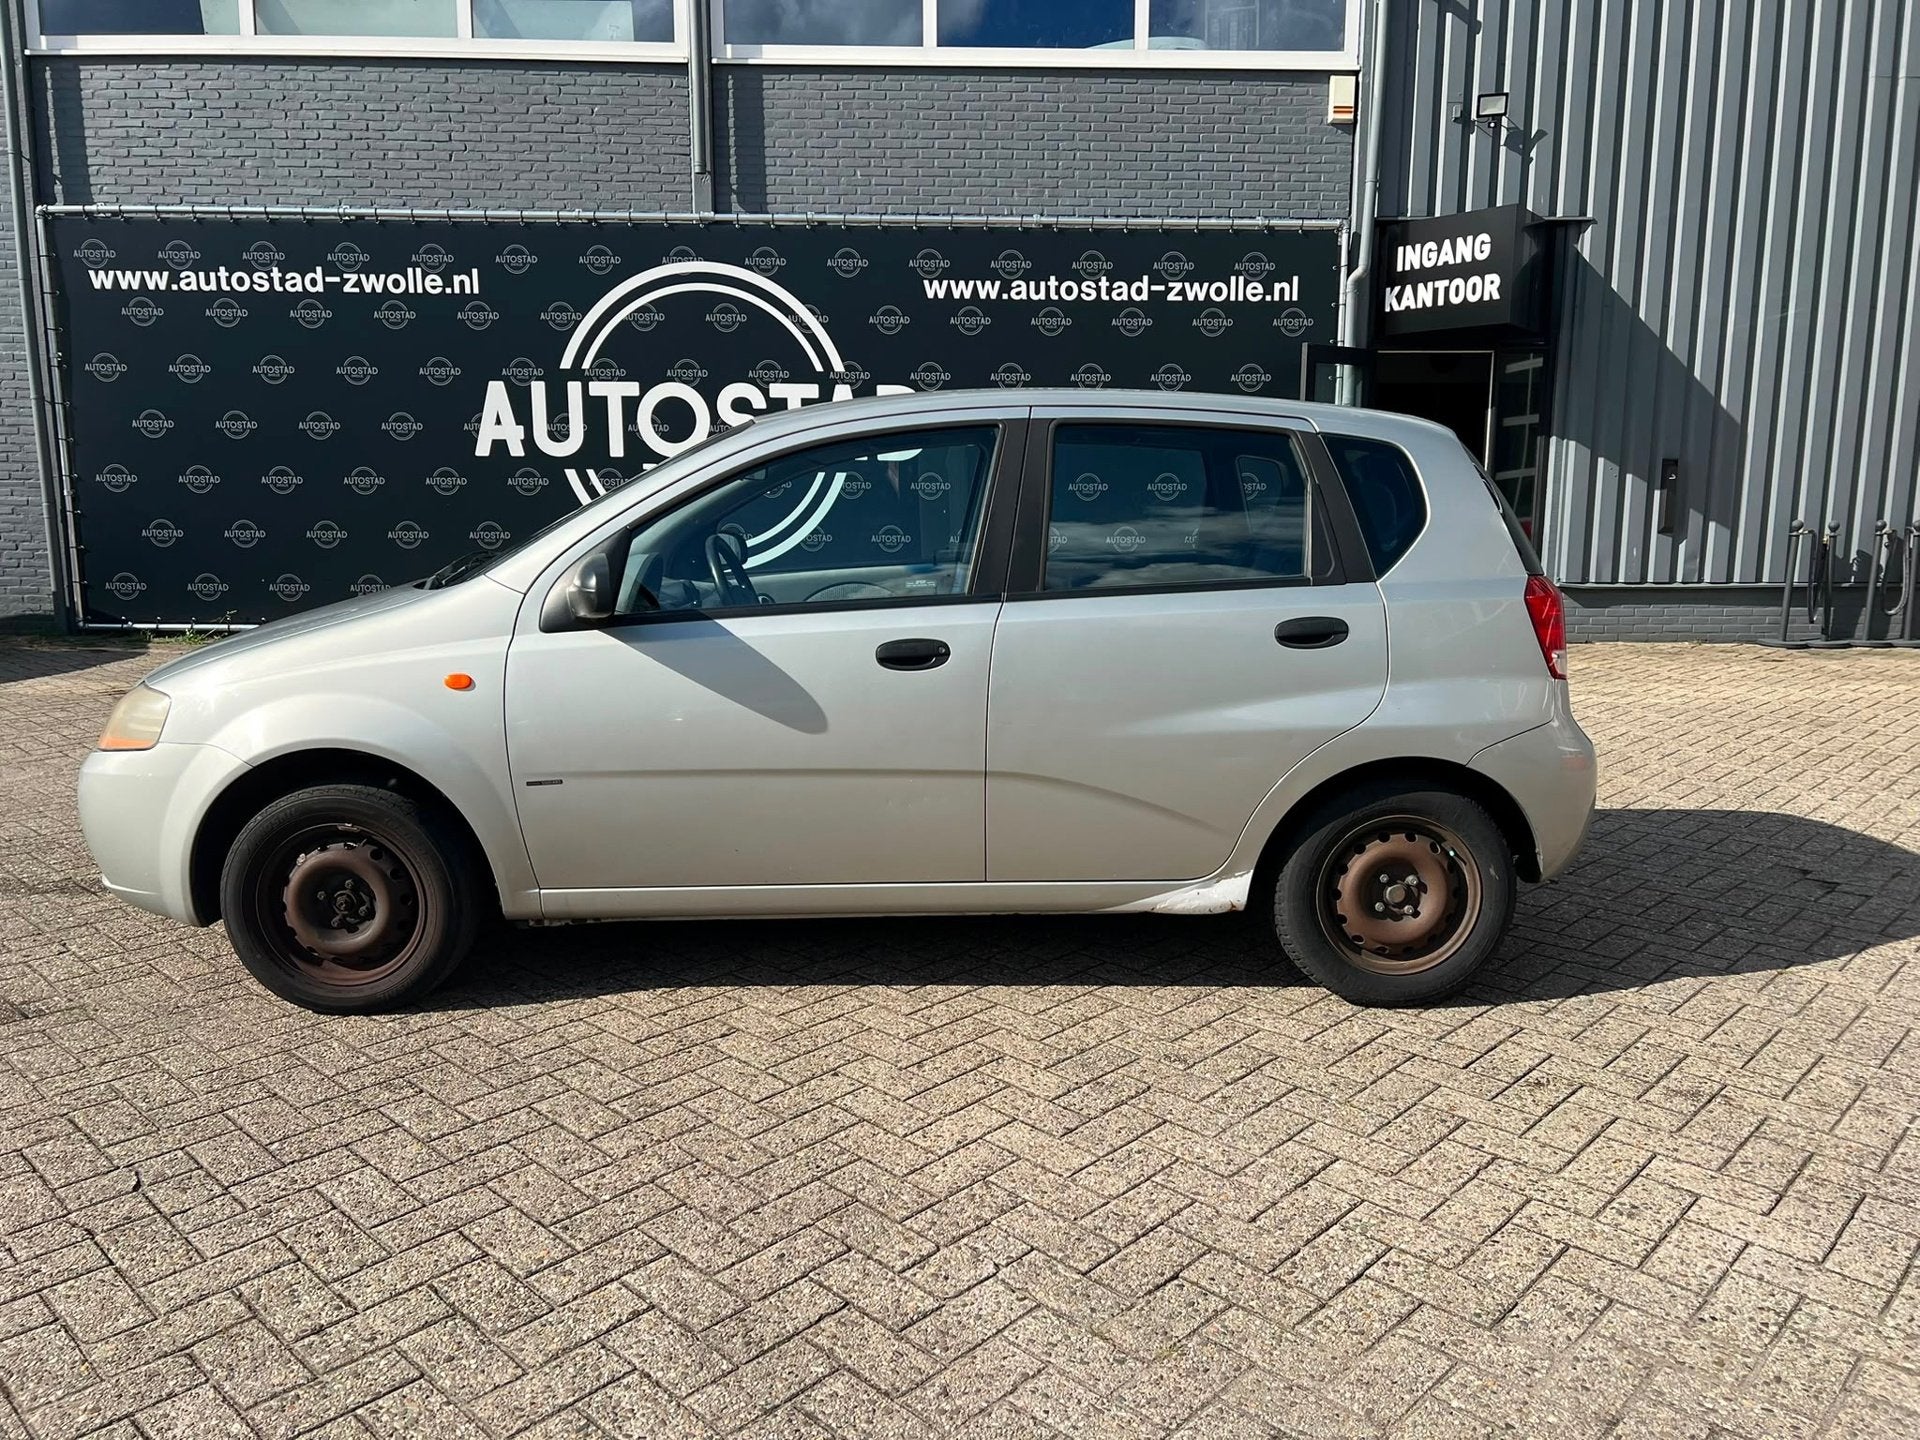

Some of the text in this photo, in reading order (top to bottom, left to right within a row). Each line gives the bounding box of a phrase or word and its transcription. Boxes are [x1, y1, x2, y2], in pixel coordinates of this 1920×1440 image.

[73, 249, 116, 258] AUTOSTAD
[158, 250, 200, 259] AUTOSTAD
[242, 251, 285, 260] AUTOSTAD
[327, 252, 370, 262] AUTOSTAD
[1396, 233, 1492, 272] INGANG
[411, 254, 454, 263] AUTOSTAD
[496, 254, 538, 263] AUTOSTAD
[579, 255, 621, 264] AUTOSTAD
[744, 257, 786, 266] AUTOSTAD
[827, 258, 868, 267] AUTOSTAD
[909, 259, 950, 268] AUTOSTAD
[991, 260, 1031, 269] AUTOSTAD
[1072, 261, 1113, 270] AUTOSTAD
[1153, 261, 1194, 270] AUTOSTAD
[1234, 262, 1275, 271] AUTOSTAD
[88, 266, 479, 294] www.autostad-zwolle.nl
[923, 275, 1299, 302] www.autostad-zwolle.nl
[1384, 273, 1501, 312] KANTOOR
[121, 307, 164, 316] AUTOSTAD
[205, 308, 248, 317] AUTOSTAD
[290, 309, 332, 318] AUTOSTAD
[373, 310, 416, 319] AUTOSTAD
[457, 311, 500, 320] AUTOSTAD
[540, 311, 582, 320] AUTOSTAD
[706, 313, 747, 322] AUTOSTAD
[869, 315, 910, 324] AUTOSTAD
[950, 316, 991, 325] AUTOSTAD
[1031, 317, 1072, 326] AUTOSTAD
[1112, 318, 1152, 327] AUTOSTAD
[1192, 318, 1233, 327] AUTOSTAD
[1273, 318, 1313, 327] AUTOSTAD
[85, 363, 127, 372] AUTOSTAD
[168, 364, 211, 373] AUTOSTAD
[252, 365, 295, 374] AUTOSTAD
[336, 366, 378, 375] AUTOSTAD
[419, 366, 461, 375] AUTOSTAD
[502, 367, 544, 376] AUTOSTAD
[584, 368, 626, 377] AUTOSTAD
[666, 368, 708, 377] AUTOSTAD
[748, 369, 789, 378] AUTOSTAD
[829, 371, 870, 380] AUTOSTAD
[910, 372, 950, 381] AUTOSTAD
[990, 373, 1031, 382] AUTOSTAD
[1070, 373, 1111, 382] AUTOSTAD
[1151, 373, 1191, 382] AUTOSTAD
[1231, 373, 1271, 382] AUTOSTAD
[132, 420, 174, 429] AUTOSTAD
[215, 421, 257, 430] AUTOSTAD
[299, 421, 341, 430] AUTOSTAD
[381, 422, 423, 431] AUTOSTAD
[96, 474, 138, 483] AUTOSTAD
[178, 475, 220, 484] AUTOSTAD
[261, 476, 303, 485] AUTOSTAD
[344, 476, 385, 485] AUTOSTAD
[425, 477, 467, 486] AUTOSTAD
[507, 477, 549, 486] AUTOSTAD
[911, 481, 951, 490] AUTOSTAD
[1068, 483, 1108, 491] AUTOSTAD
[1147, 483, 1187, 491] AUTOSTAD
[141, 529, 183, 538] AUTOSTAD
[224, 529, 266, 538] AUTOSTAD
[306, 530, 348, 539] AUTOSTAD
[388, 530, 429, 539] AUTOSTAD
[469, 531, 510, 540] AUTOSTAD
[871, 534, 911, 543] AUTOSTAD
[1106, 536, 1146, 544] AUTOSTAD
[105, 582, 147, 591] AUTOSTAD
[187, 583, 229, 592] AUTOSTAD
[269, 583, 310, 592] AUTOSTAD
